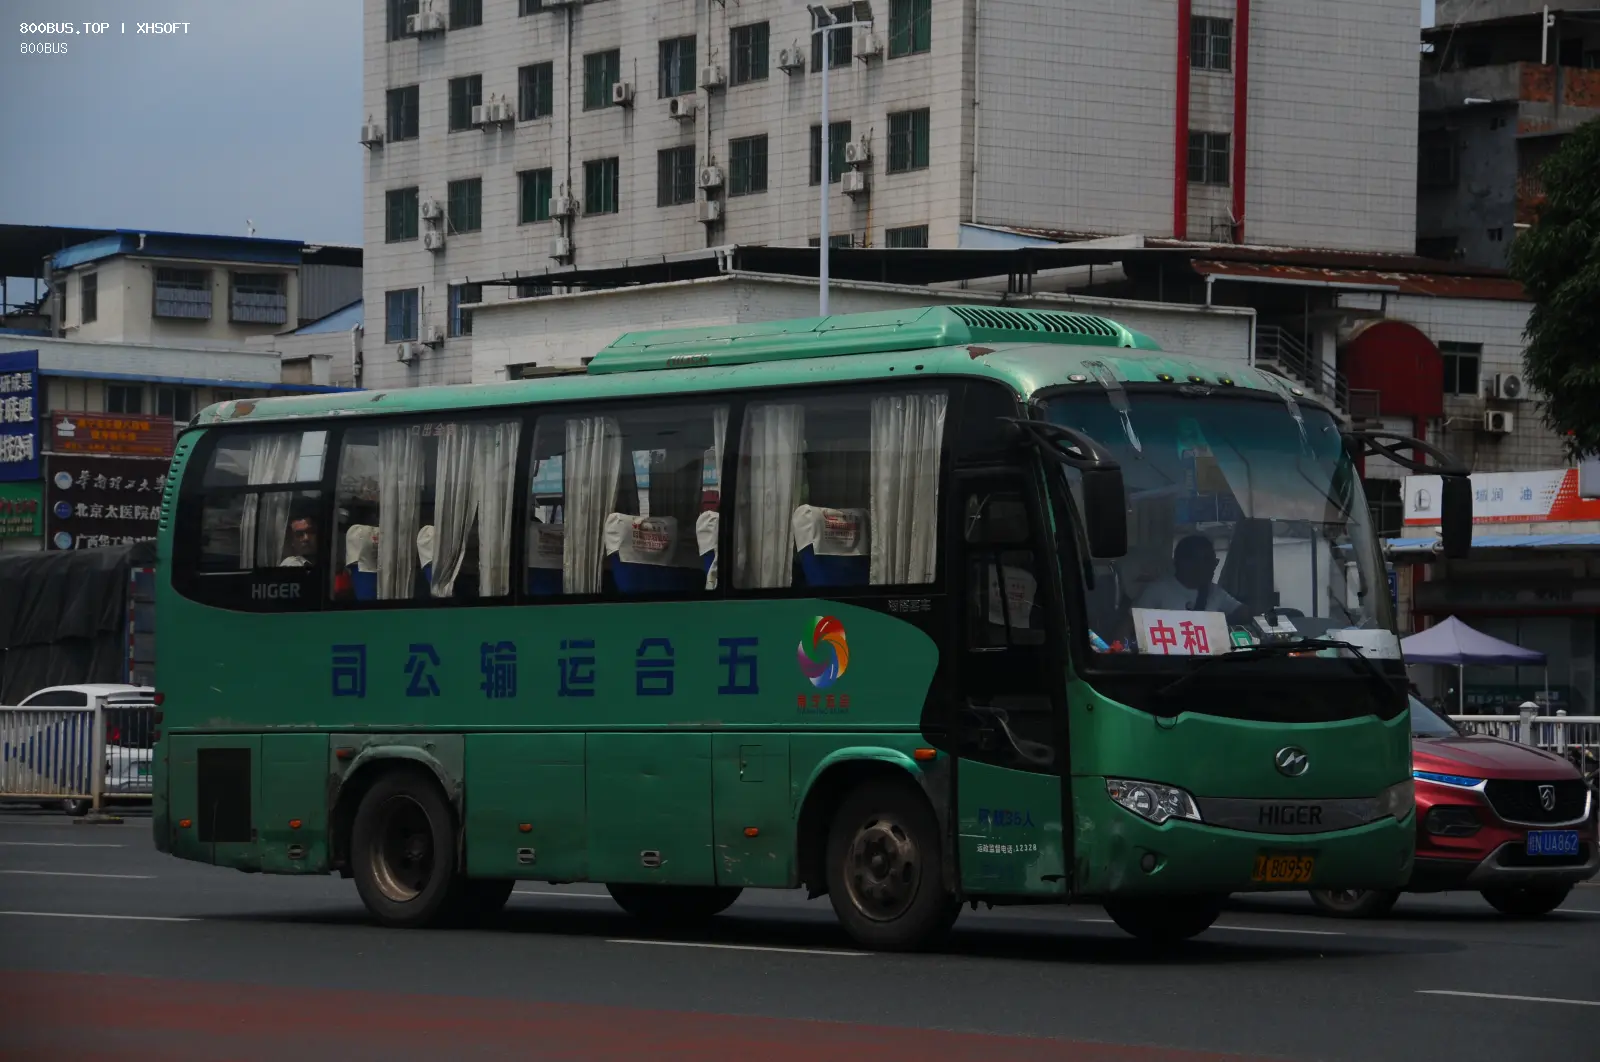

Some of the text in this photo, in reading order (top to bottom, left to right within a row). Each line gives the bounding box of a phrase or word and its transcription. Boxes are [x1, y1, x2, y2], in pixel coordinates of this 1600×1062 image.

[251, 582, 301, 600] HIGER
[1149, 619, 1210, 656] 中和
[1257, 805, 1323, 825] HIGER
